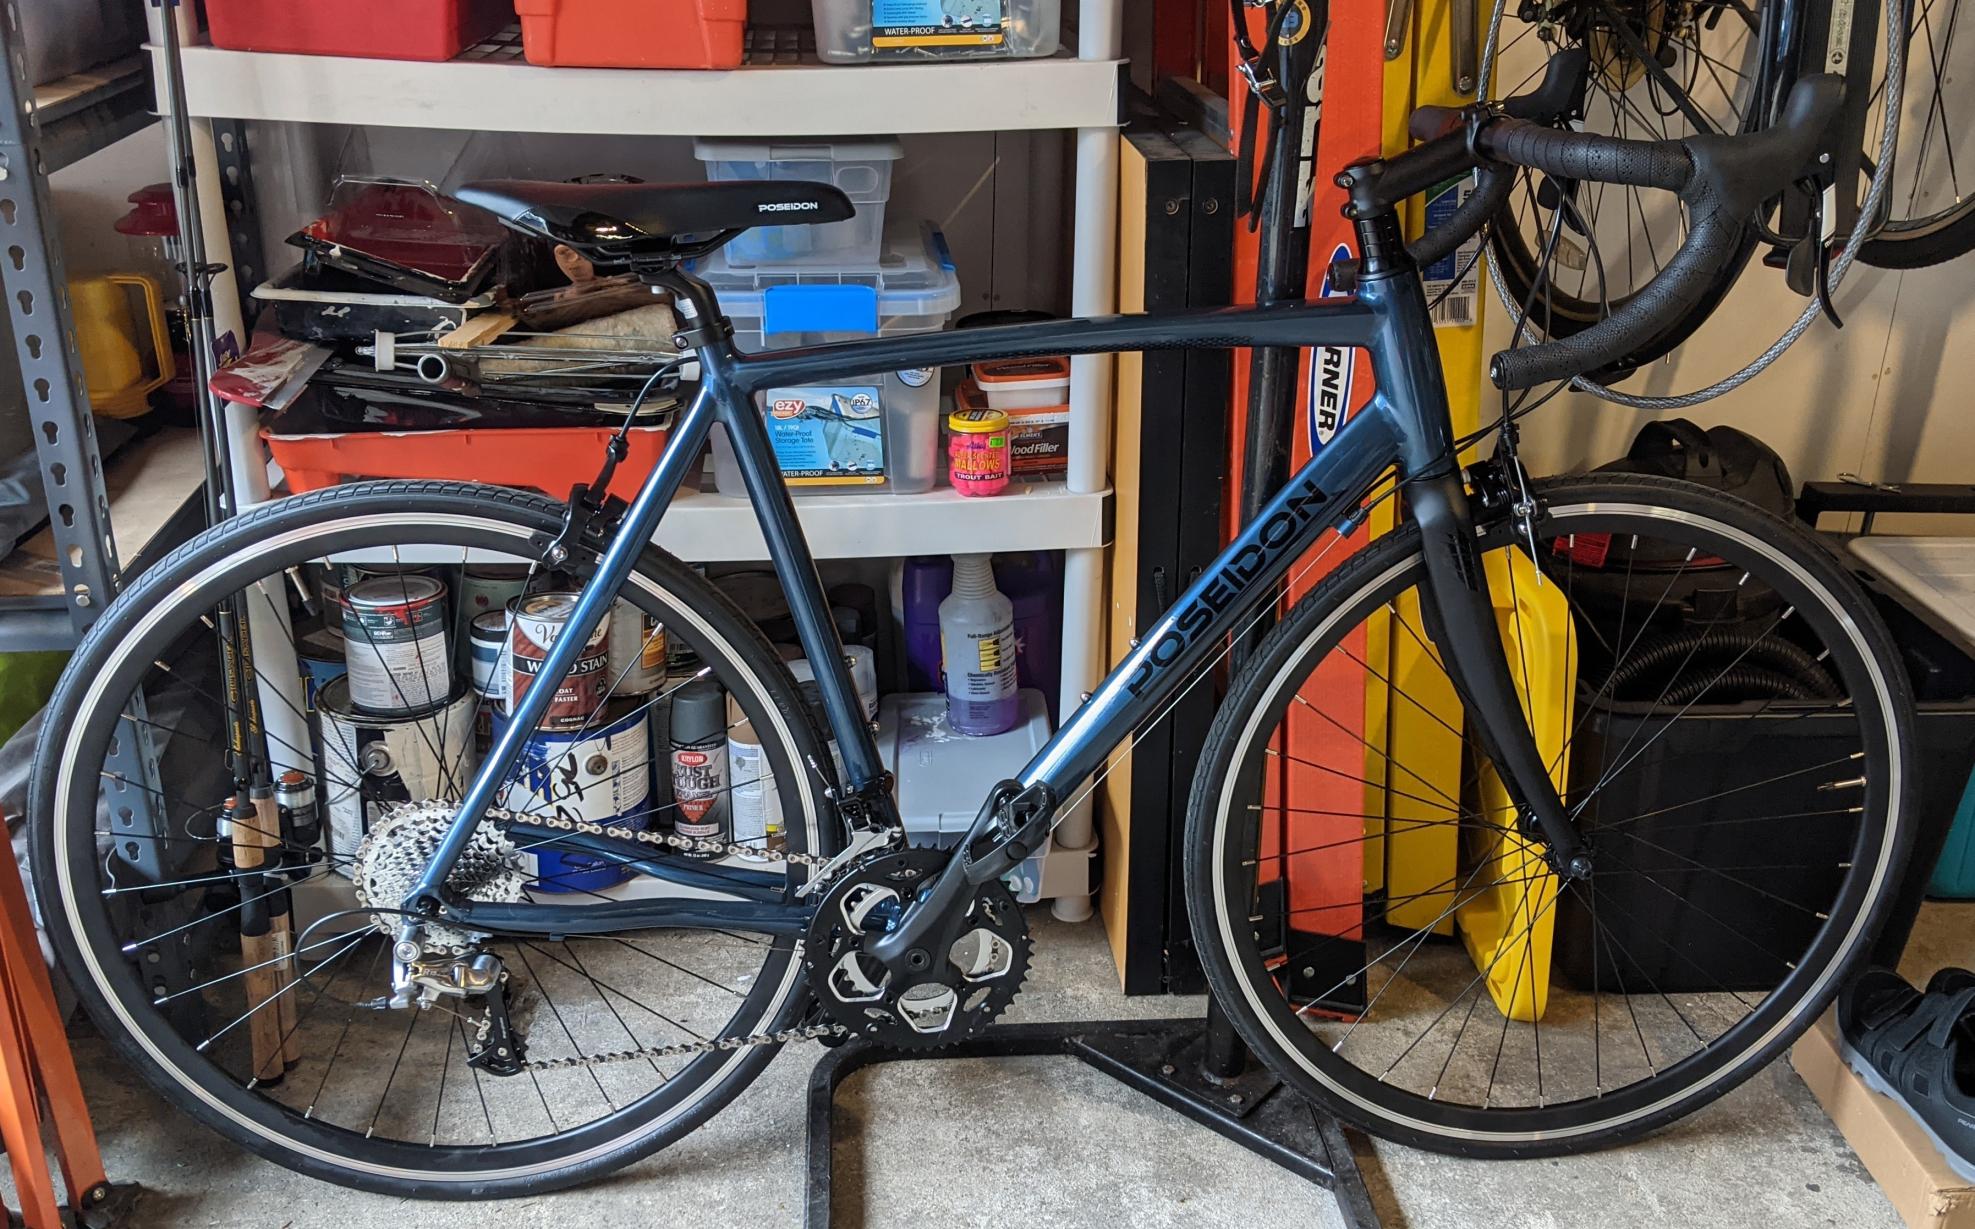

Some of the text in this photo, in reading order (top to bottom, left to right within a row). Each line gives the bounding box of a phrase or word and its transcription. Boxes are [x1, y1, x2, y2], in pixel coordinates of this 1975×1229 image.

[884, 27, 935, 36] WATER-PROOF
[758, 201, 818, 213] POSEIDON
[1318, 347, 1342, 432] RNER
[775, 401, 803, 414] ezy
[1011, 442, 1060, 455] ood Filler
[954, 458, 1000, 471] MALLOWS
[956, 472, 1003, 480] TROUT BAIT
[1126, 480, 1328, 698] POSEIDON
[581, 654, 609, 672] STAIN
[681, 755, 705, 763] KRYLON
